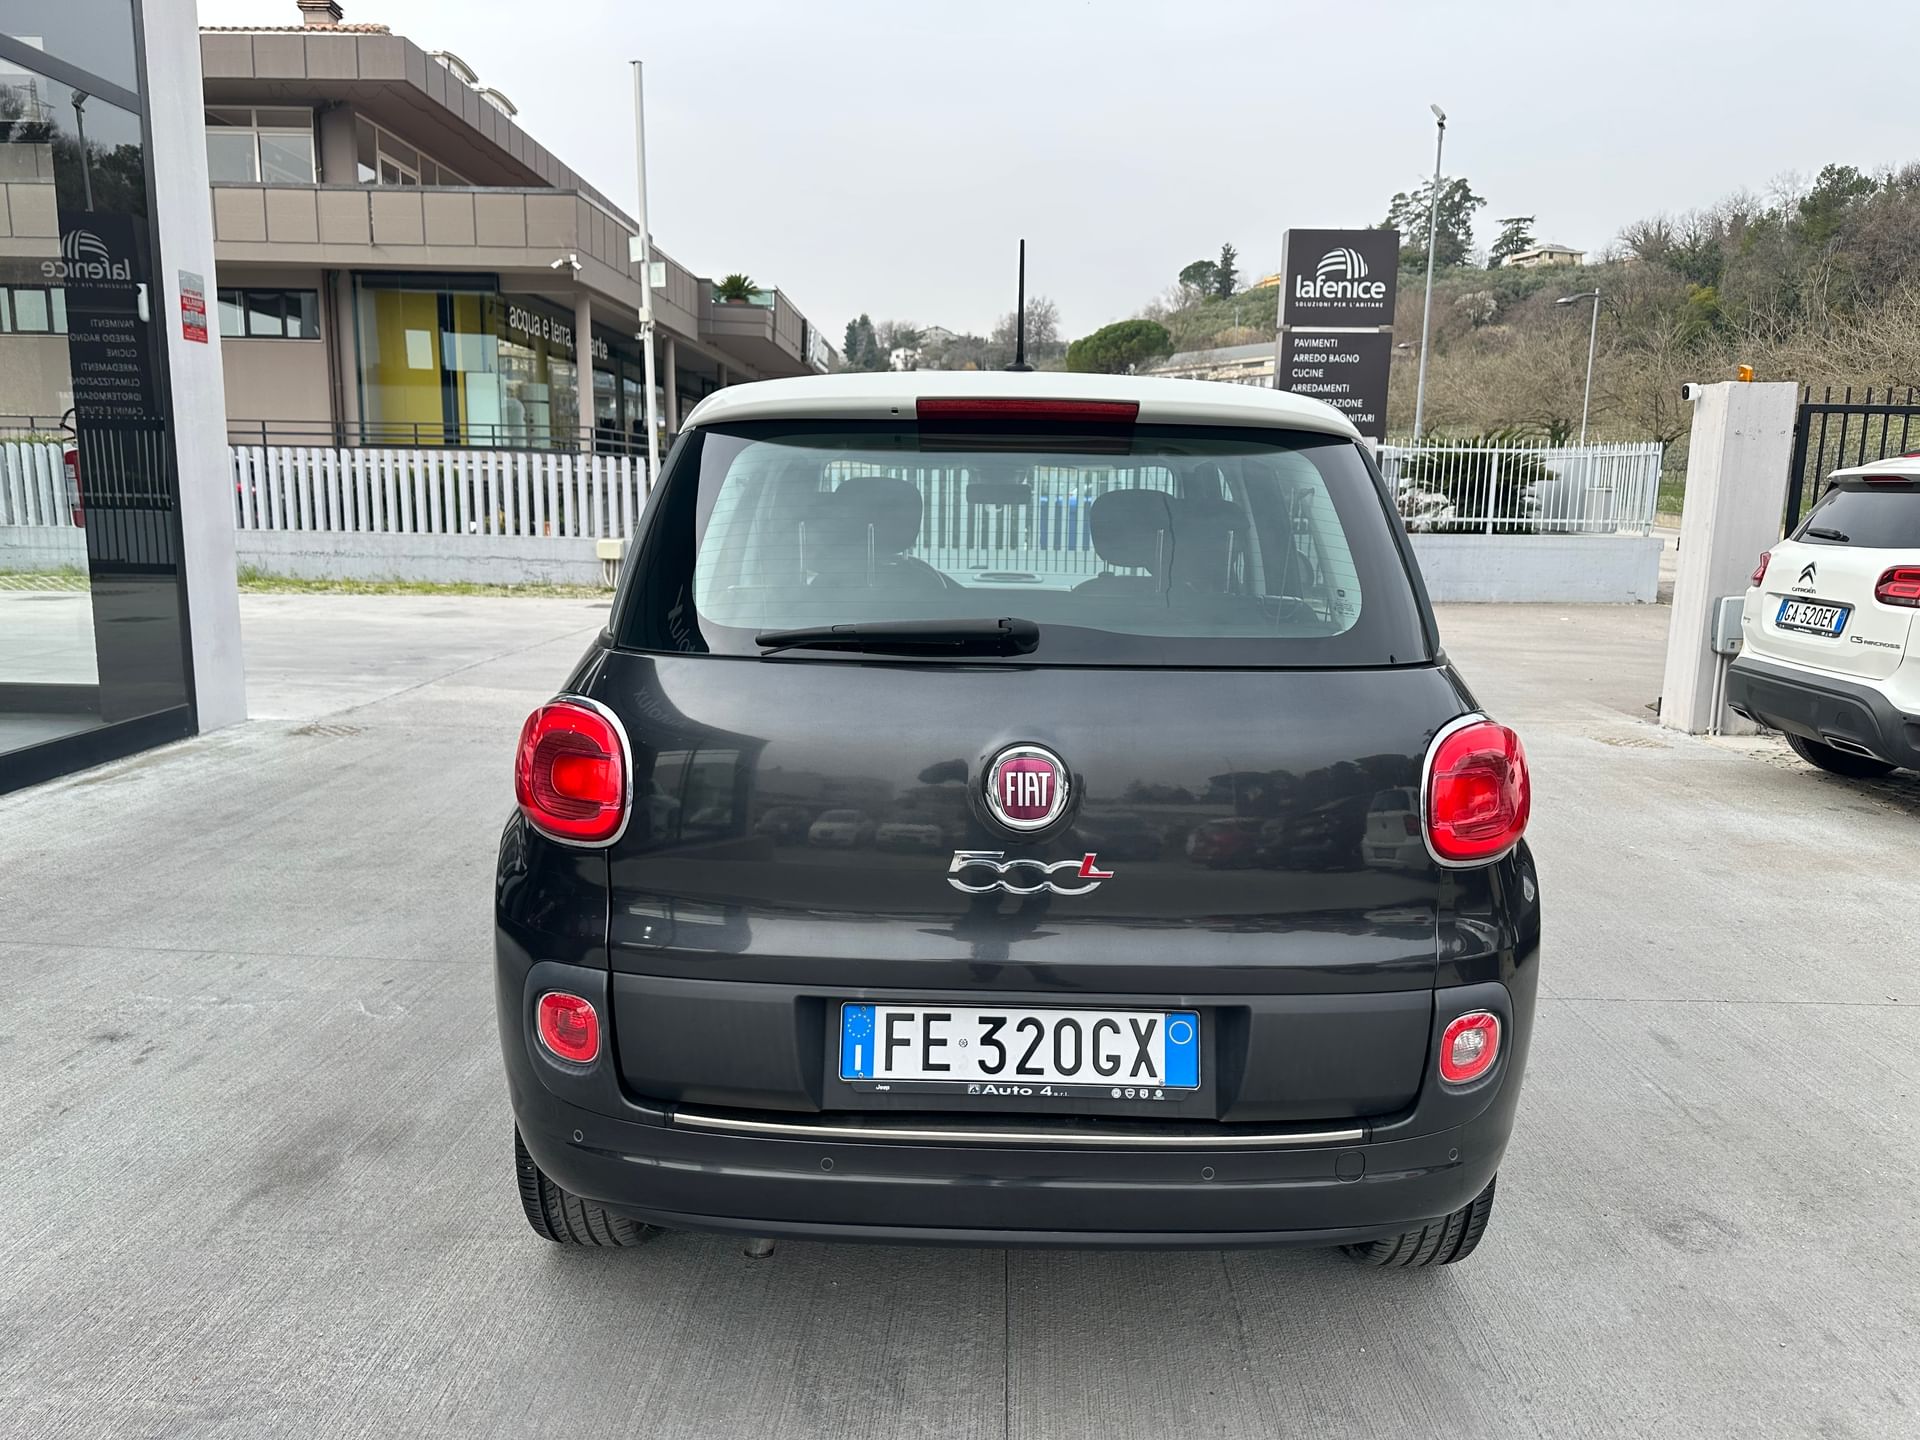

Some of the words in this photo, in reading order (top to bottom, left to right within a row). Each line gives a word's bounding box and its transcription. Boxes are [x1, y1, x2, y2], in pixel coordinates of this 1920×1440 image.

[1295, 274, 1386, 299] lafenice
[509, 306, 541, 339] acqua
[542, 318, 550, 340] e
[1294, 338, 1338, 348] PAVIMENTI
[1293, 354, 1327, 362] ARREDO
[1328, 354, 1360, 363] BAGNO
[1292, 368, 1324, 378] CUCINE
[1291, 384, 1350, 392] ARREDAMENTI
[1784, 604, 1799, 622] GA
[1800, 606, 1838, 630] 520EK
[1006, 772, 1051, 807] FIAT
[885, 1013, 952, 1072] FE
[977, 1016, 1158, 1078] 320GX
[982, 1084, 1033, 1096] Auto
[1040, 1086, 1053, 1096] 4
